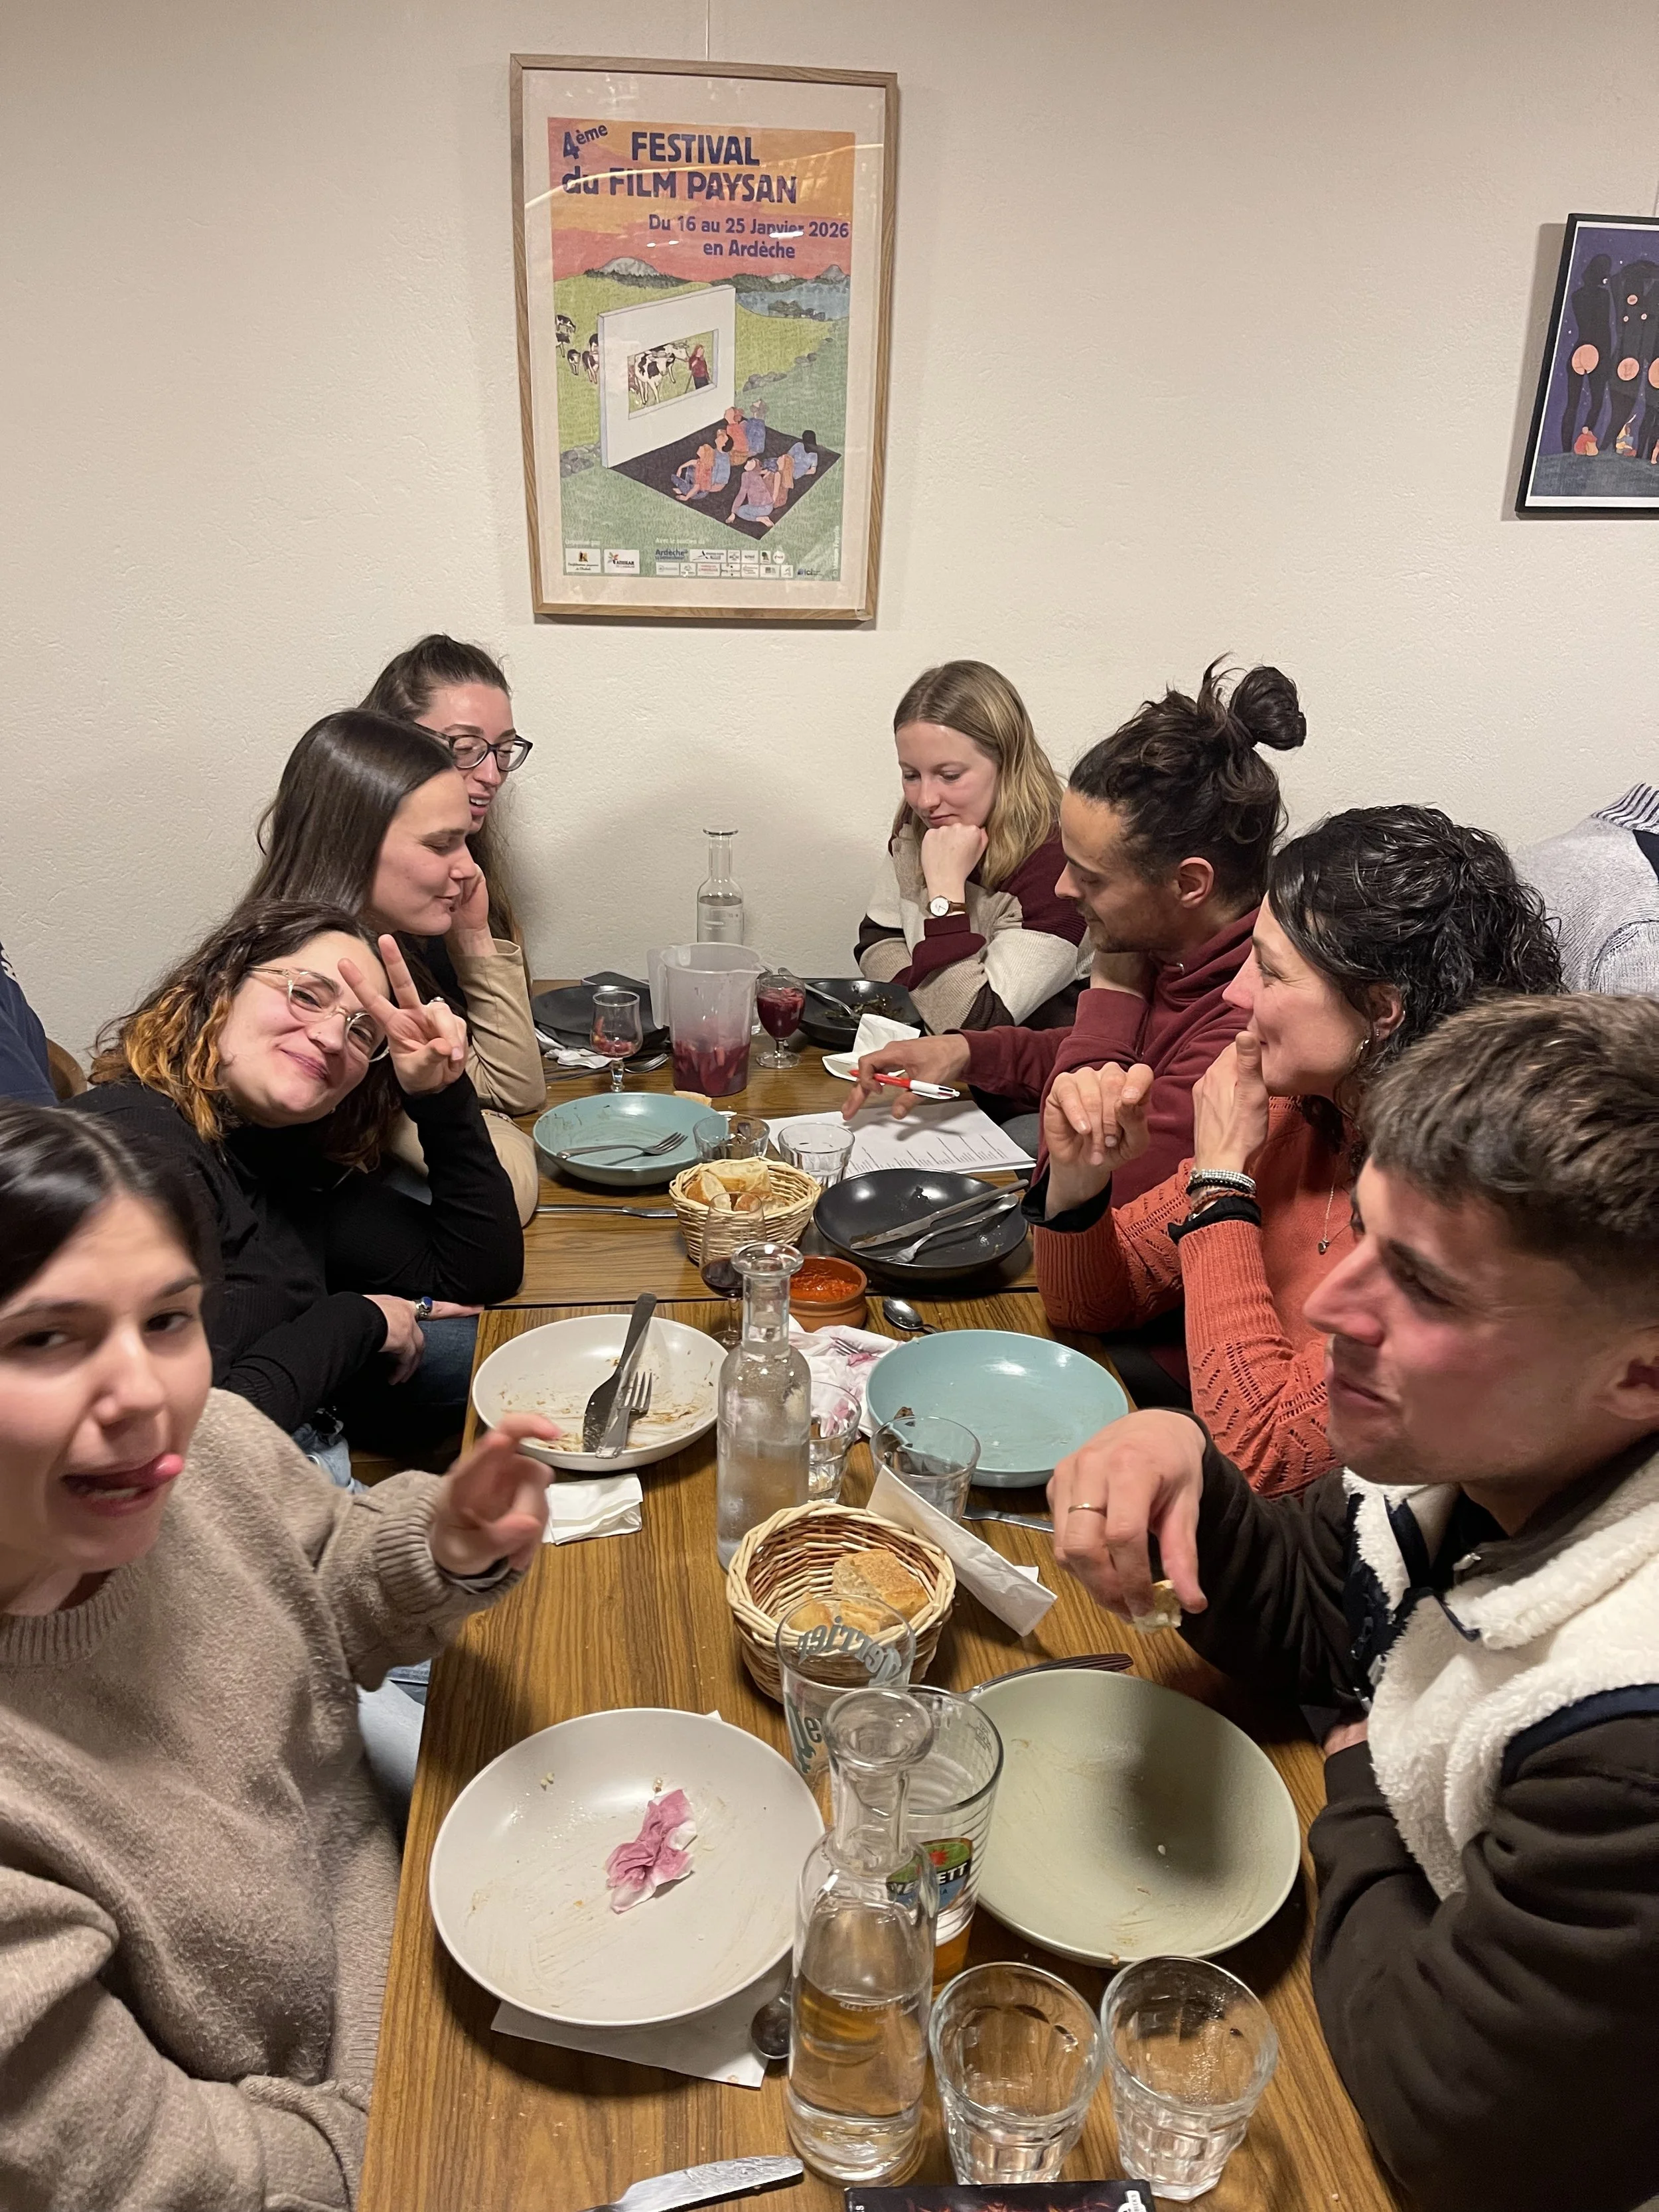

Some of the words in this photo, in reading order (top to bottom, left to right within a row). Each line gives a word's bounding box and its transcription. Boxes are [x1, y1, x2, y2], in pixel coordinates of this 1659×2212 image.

[563, 124, 609, 160] 4ème
[632, 131, 760, 167] FESTIVAL
[562, 165, 599, 195] du
[609, 167, 677, 198] FILM
[687, 171, 797, 204] PAYSAN
[648, 214, 671, 231] Du
[677, 215, 697, 232] 16
[701, 219, 721, 234] au
[725, 217, 745, 234] 25
[751, 218, 804, 237] Janvier
[808, 221, 849, 238] 2026
[703, 242, 723, 256] en
[728, 239, 796, 259] Ardèche
